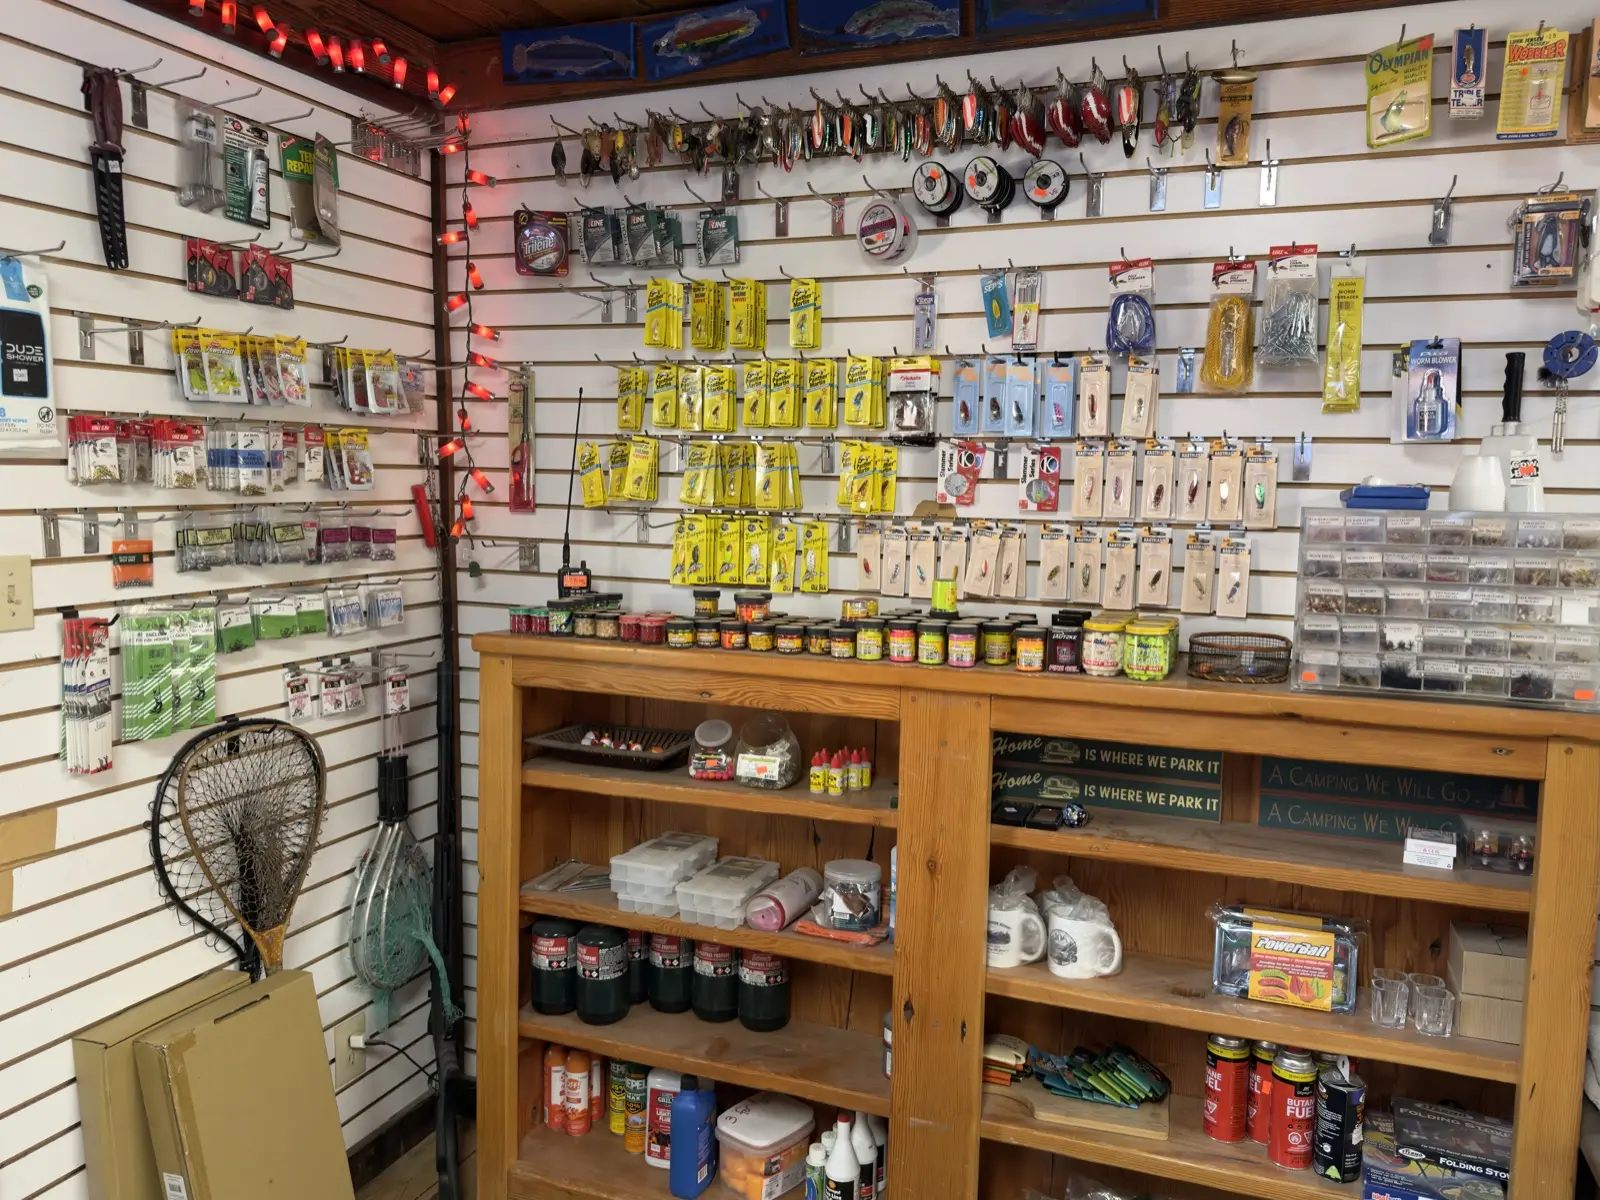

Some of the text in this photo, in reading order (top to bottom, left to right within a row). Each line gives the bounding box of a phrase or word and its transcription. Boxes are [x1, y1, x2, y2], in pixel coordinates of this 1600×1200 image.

[1509, 39, 1566, 61] WOBBLER
[1369, 49, 1429, 74] OLYMPIAN
[523, 235, 555, 255] Trilene
[6, 343, 44, 356] DUDE
[6, 353, 44, 362] SHOWER
[1411, 356, 1457, 365] WORM BLOWER
[773, 373, 792, 383] Panther
[848, 369, 869, 380] Panther
[850, 376, 867, 385] Martin
[774, 379, 790, 389] Martin
[1511, 459, 1539, 470] Cow
[1513, 468, 1537, 478] Bll
[992, 736, 1220, 774] Home IS WHERE WE PARK IT
[1268, 764, 1284, 785] A
[1364, 773, 1391, 795] WE
[992, 772, 1219, 811] Home IS WHERE WE PARK IT
[1267, 803, 1283, 823] A
[1363, 813, 1390, 835] WE
[1255, 936, 1332, 959] PowerBait
[626, 1080, 648, 1090] EPEL
[1286, 1098, 1315, 1107] BUTAN
[1400, 1107, 1461, 1126] FOLDING
[1439, 1157, 1484, 1174] FOLDING
